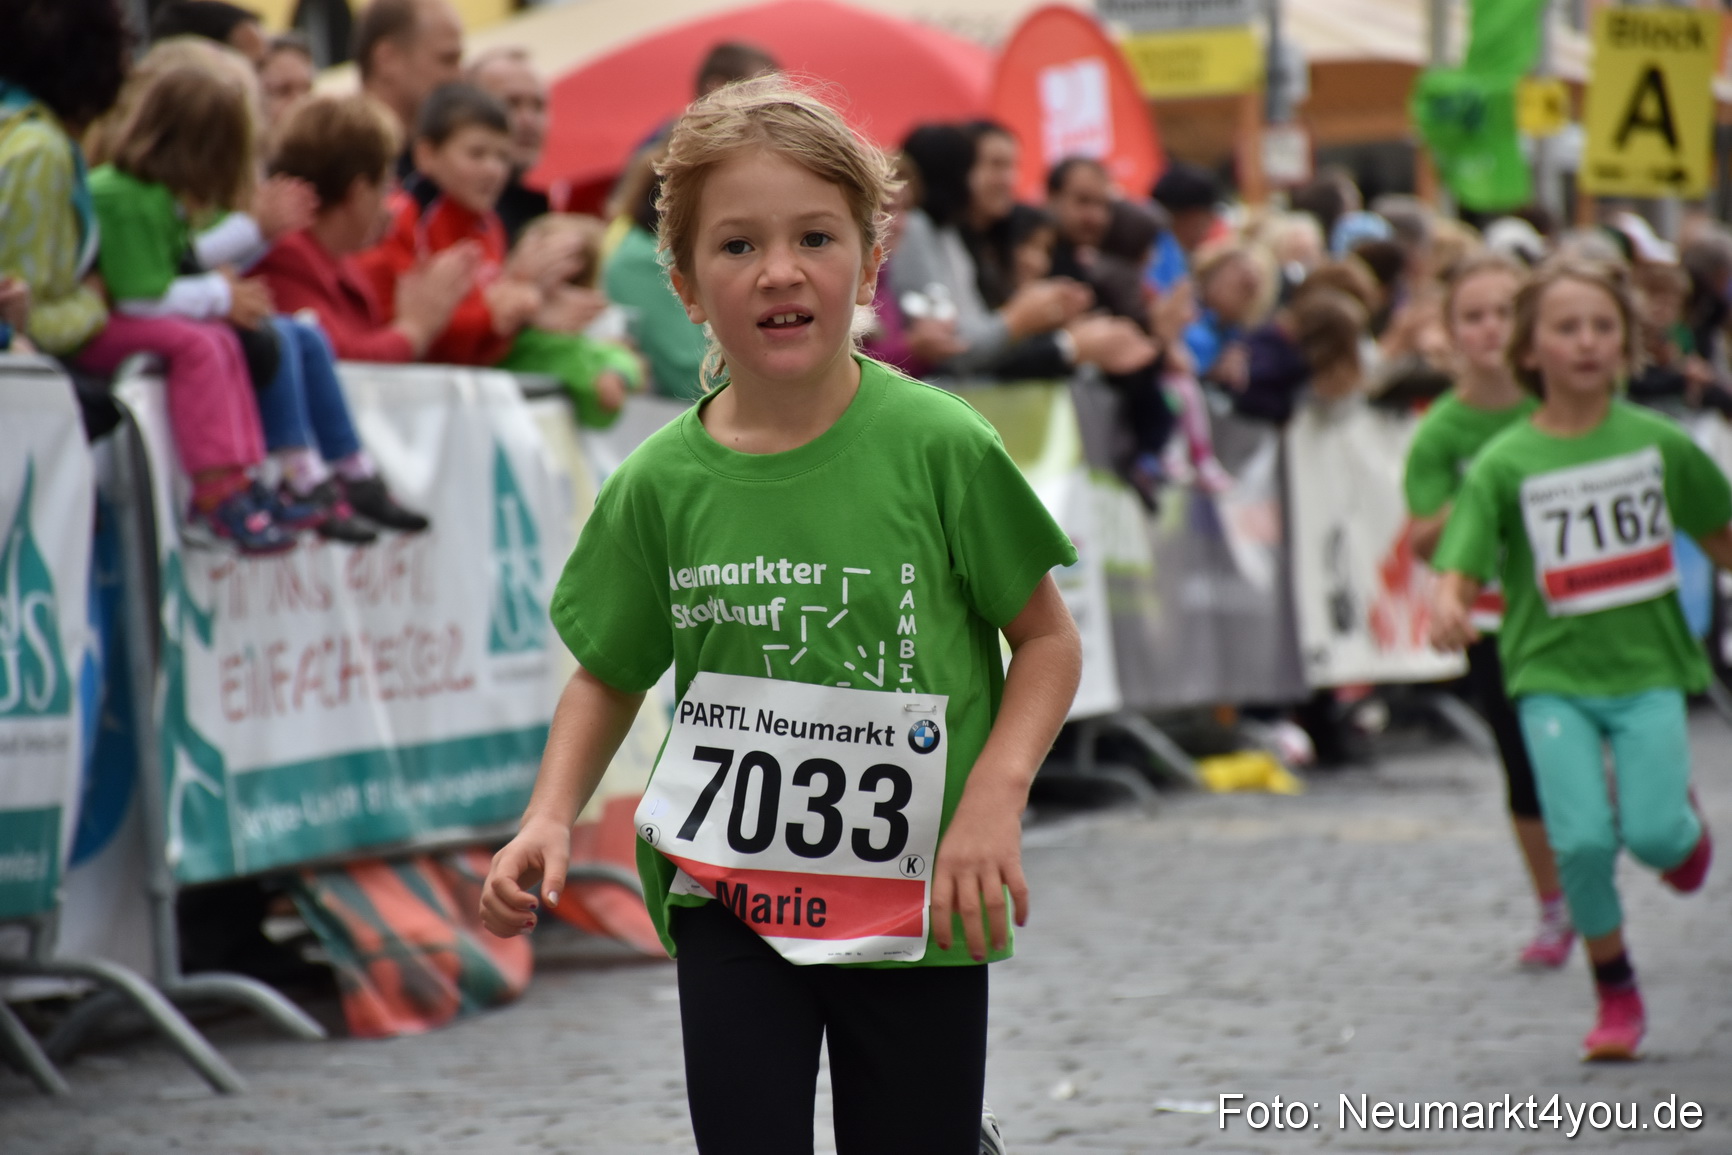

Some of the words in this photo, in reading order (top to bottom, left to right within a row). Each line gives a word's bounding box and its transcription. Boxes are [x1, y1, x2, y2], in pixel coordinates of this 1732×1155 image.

[1607, 10, 1705, 49] Block
[1612, 62, 1679, 152] A
[1543, 487, 1663, 559] 7162
[896, 563, 918, 694] BAMBI
[679, 700, 750, 732] PARTL
[756, 708, 895, 747] Neumarkt
[675, 745, 914, 863] 7033
[645, 827, 654, 843] 3
[906, 857, 918, 874] K
[715, 880, 828, 928] Marie
